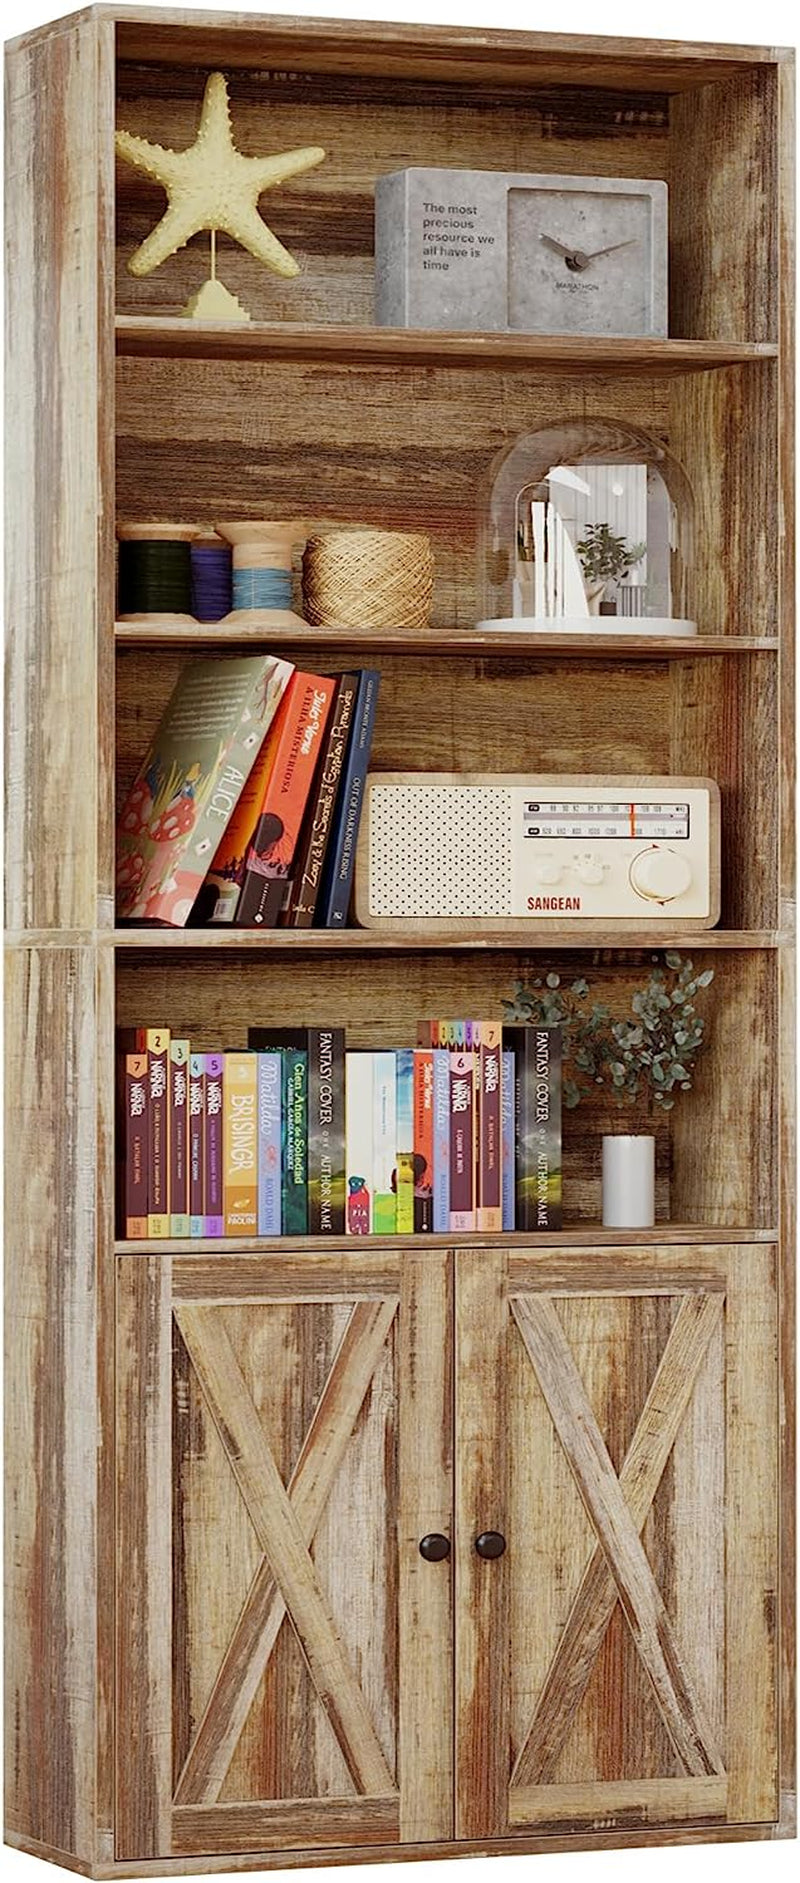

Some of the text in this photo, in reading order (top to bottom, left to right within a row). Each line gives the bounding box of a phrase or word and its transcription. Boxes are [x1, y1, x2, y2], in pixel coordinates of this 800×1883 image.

[422, 202, 478, 215] The most
[422, 218, 474, 228] precious
[422, 233, 495, 244] resource we
[422, 246, 480, 258] all have is
[422, 260, 450, 270] time
[281, 726, 304, 794] MISTERIOSA
[206, 765, 244, 822] ALICE
[340, 777, 360, 880] OUT OF DARKNESS RISING
[527, 896, 580, 911] SANGEAN
[155, 1036, 160, 1047] 2
[489, 1030, 494, 1042] 7
[134, 1061, 140, 1072] 7
[178, 1048, 182, 1059] 3
[192, 1060, 198, 1070] 4
[212, 1060, 218, 1070] 5
[320, 1032, 332, 1082] FANTASY
[457, 1058, 464, 1068] 6
[537, 1032, 548, 1080] FANTASY
[261, 1060, 279, 1136] Matilda
[320, 1084, 332, 1125] COVER
[537, 1084, 548, 1123] COVER
[230, 1094, 254, 1175] BRISINGR
[294, 1139, 304, 1184] Soledad
[321, 1154, 332, 1197] AUTHOR
[538, 1152, 548, 1193] AUTHOR
[321, 1200, 332, 1230] NAME
[538, 1196, 548, 1226] NAME
